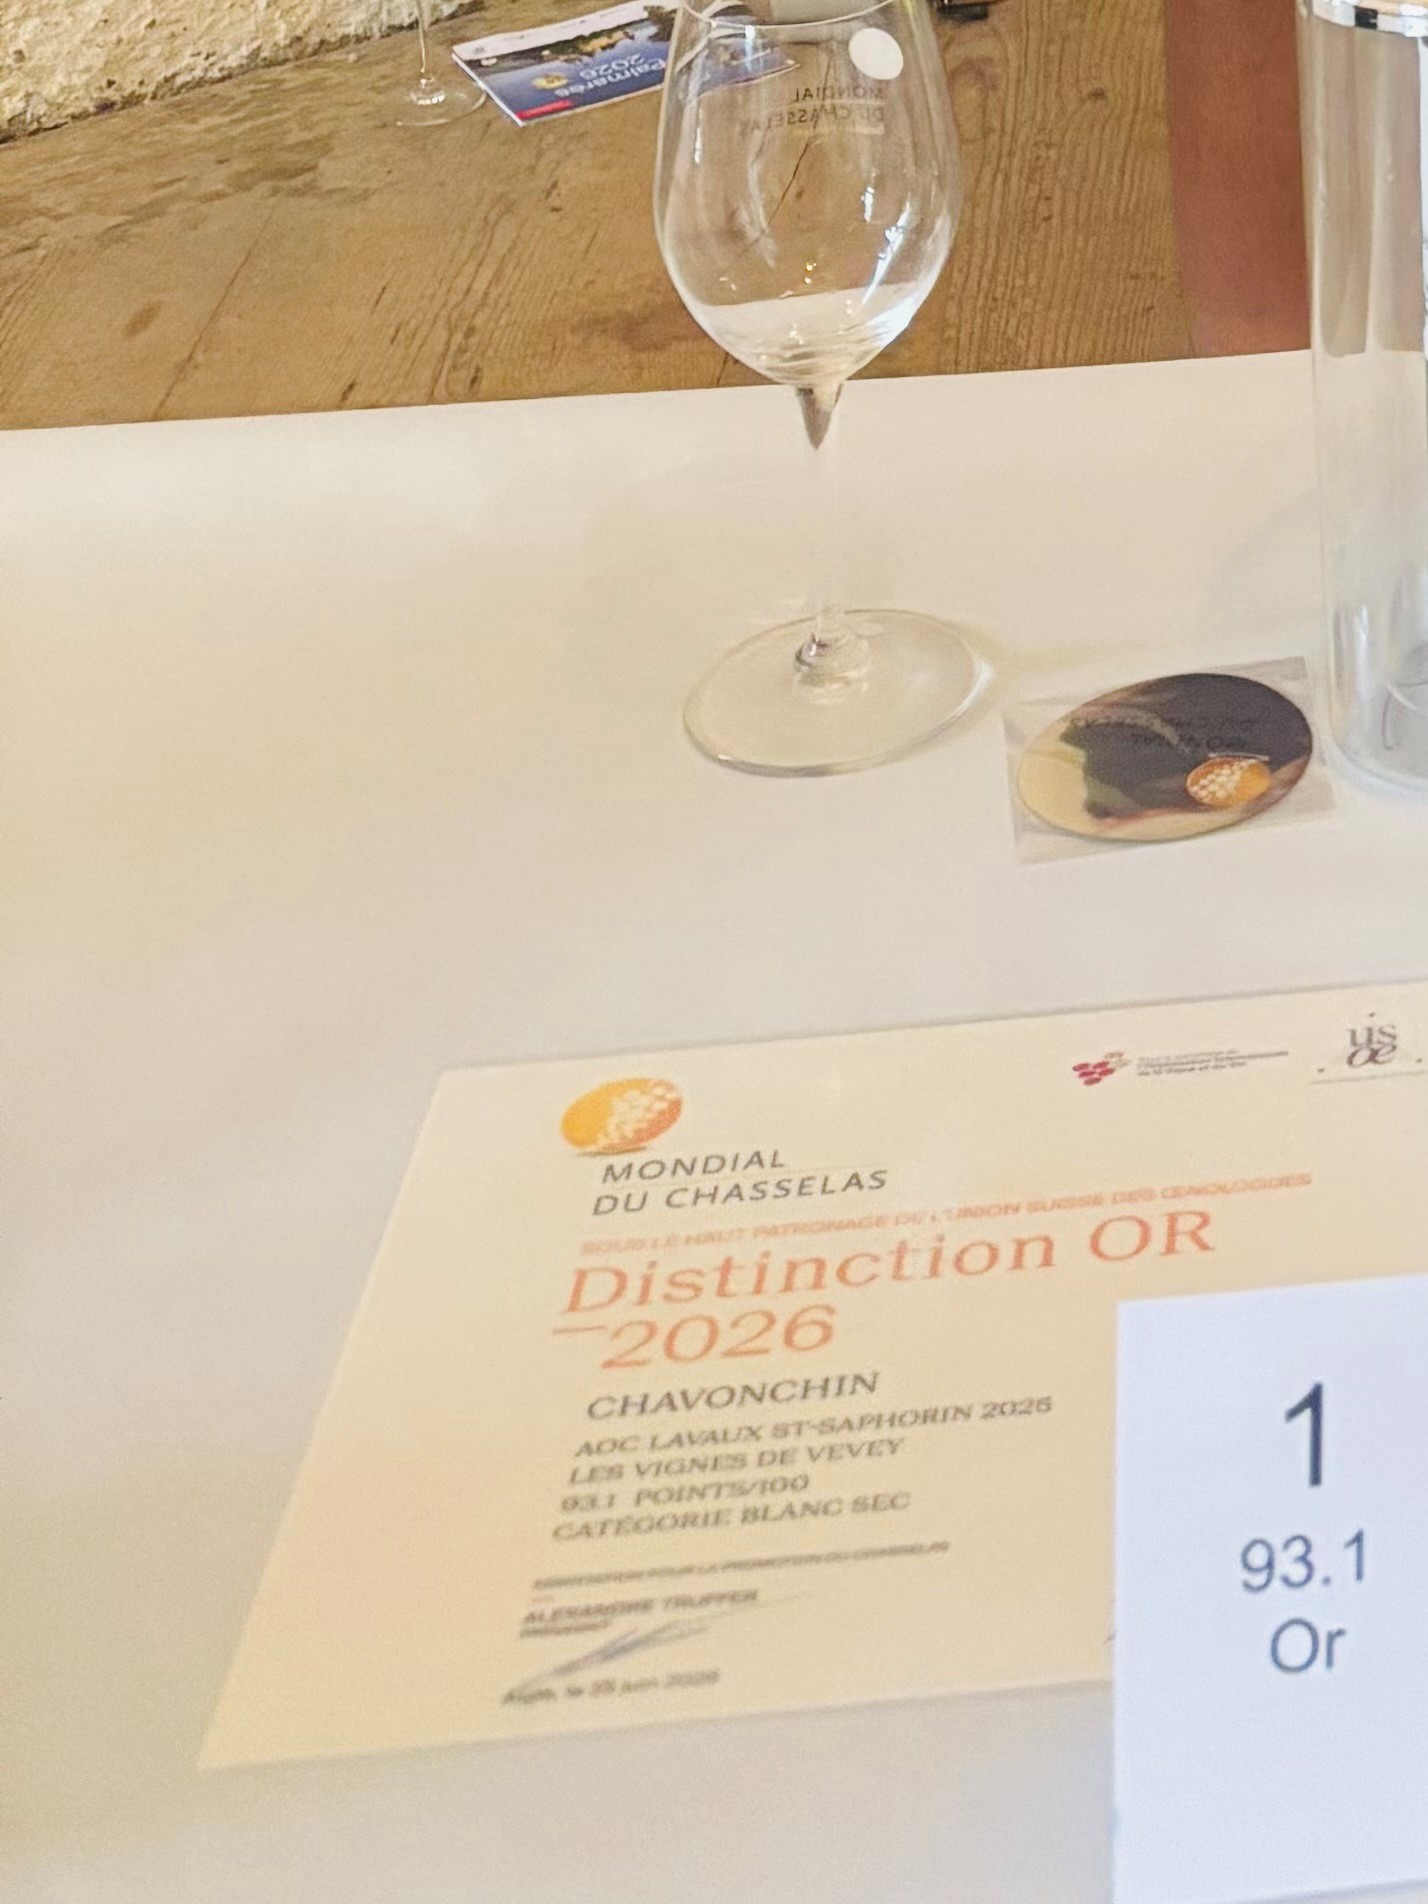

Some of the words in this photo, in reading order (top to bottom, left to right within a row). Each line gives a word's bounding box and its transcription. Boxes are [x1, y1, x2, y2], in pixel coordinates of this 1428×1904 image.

[602, 1148, 786, 1184] MONDIAL
[592, 1192, 648, 1216] DU
[664, 1168, 888, 1210] CHASSELAS
[565, 1232, 1058, 1317] Distinction
[1088, 1209, 1216, 1264] OR
[600, 1303, 837, 1370] 2026
[587, 1371, 881, 1420] CHAVONCHIN
[574, 1435, 641, 1458] AOC
[649, 1424, 763, 1452] LAVAUX
[1283, 1383, 1324, 1488] 1
[569, 1464, 625, 1486] LES
[634, 1452, 748, 1479] VIGNES
[757, 1447, 798, 1469] DE
[806, 1437, 907, 1464] VEVEY
[634, 1473, 810, 1507] POINTS/100
[740, 1496, 845, 1525] BLANC
[851, 1491, 912, 1514] SEC
[1240, 1530, 1369, 1593] 93.1
[1269, 1617, 1347, 1674] Or
